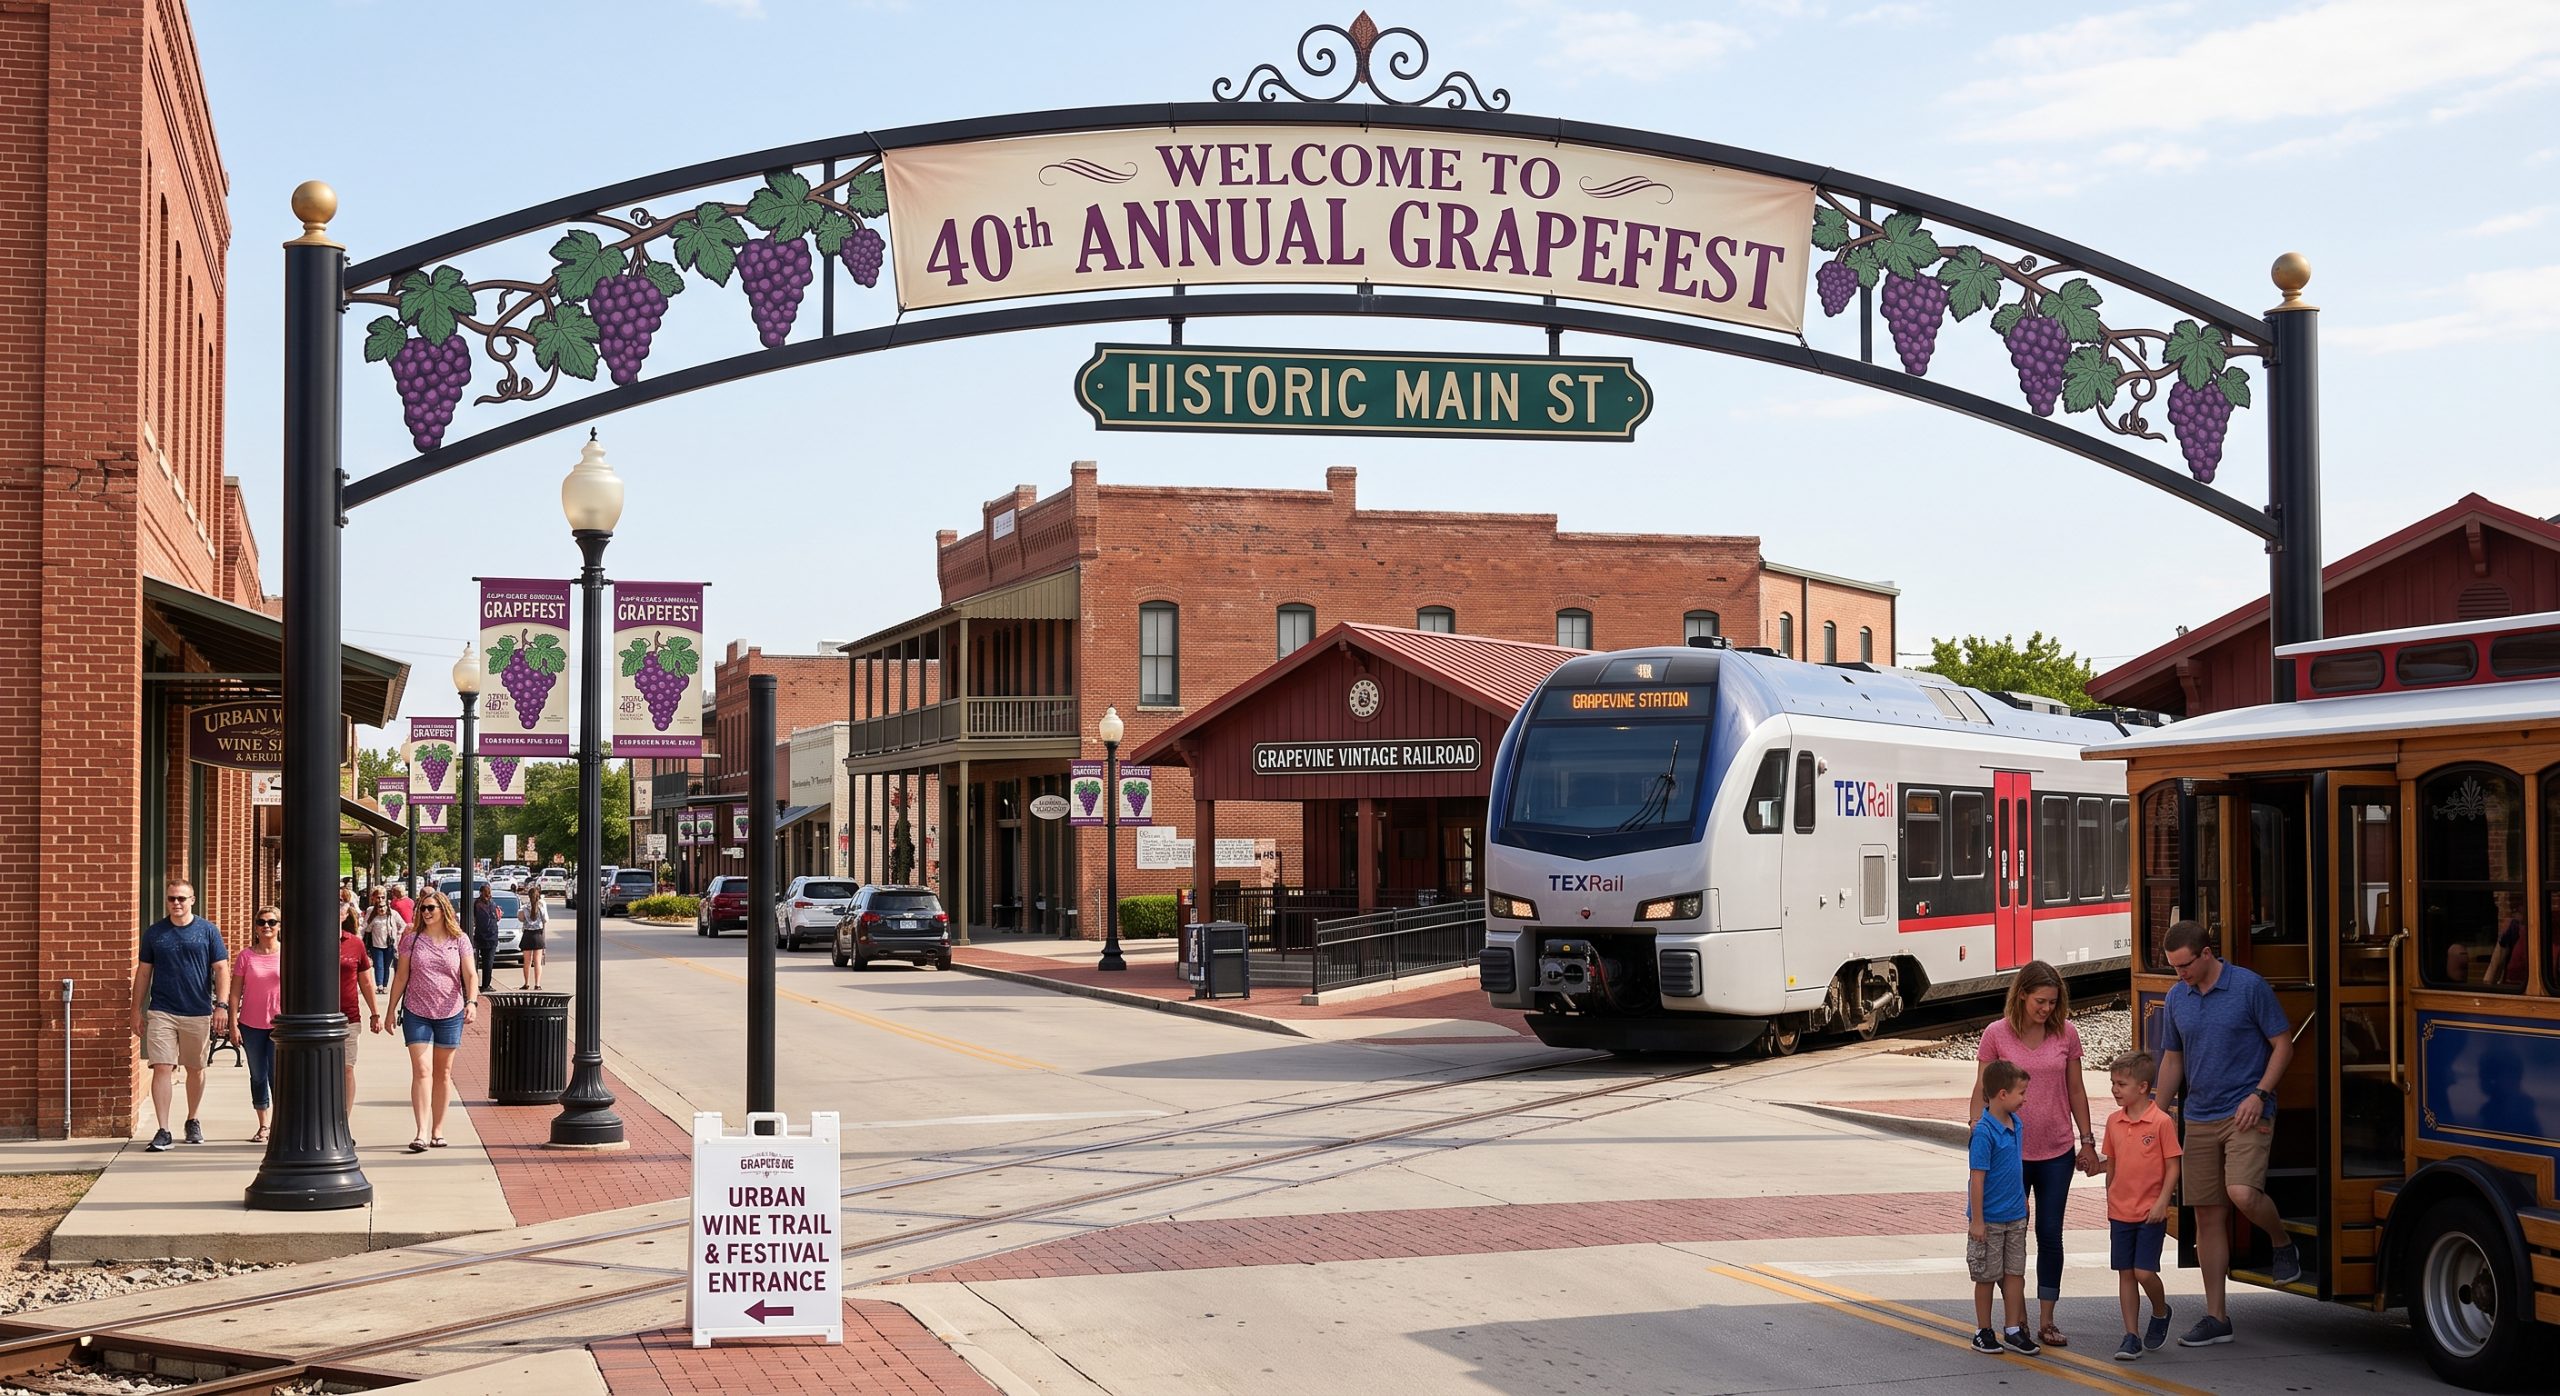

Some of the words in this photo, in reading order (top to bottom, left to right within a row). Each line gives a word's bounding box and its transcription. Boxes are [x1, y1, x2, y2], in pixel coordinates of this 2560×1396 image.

[1155, 143, 1462, 191] WELCOME
[1482, 152, 1561, 199] TO
[926, 206, 1053, 287] 40th
[1076, 197, 1365, 274] ANNUAL
[1389, 200, 1785, 311] GRAPEFEST
[1127, 362, 1368, 419] HISTORIC
[1395, 369, 1519, 422] MAIN
[1547, 373, 1604, 425] ST
[484, 601, 566, 620] GRAPEFEST
[618, 604, 699, 622] GRAPEFEST
[1573, 693, 1635, 709] GRAPEVINE
[1639, 692, 1688, 707] STATION
[203, 708, 268, 733] URBAN
[217, 738, 262, 751] WINE
[236, 753, 243, 761] &
[1258, 748, 1334, 768] GRAPEVINE
[1339, 747, 1398, 766] VINTAGE
[1403, 745, 1475, 765] RAILROAD
[1834, 780, 1893, 817] TEXRail
[1548, 875, 1623, 891] TEXRail
[729, 1186, 805, 1207] URBAN
[702, 1214, 761, 1235] WINE
[768, 1214, 832, 1235] TRAIL
[705, 1243, 719, 1264] &
[727, 1242, 829, 1263] FESTIVAL
[708, 1271, 826, 1293] ENTRANCE
